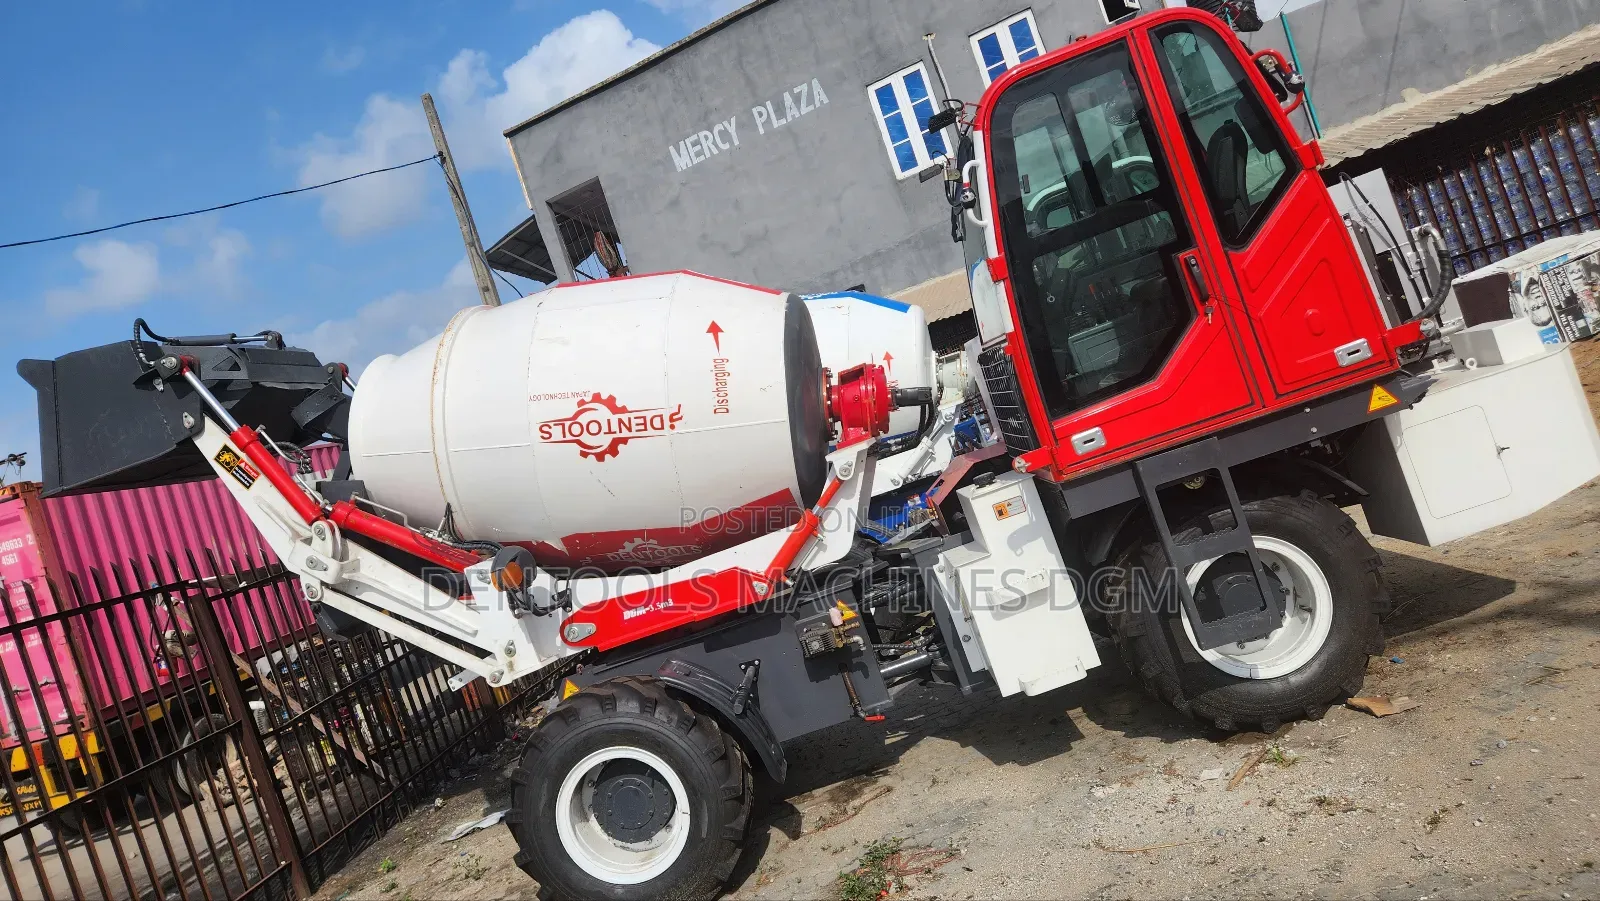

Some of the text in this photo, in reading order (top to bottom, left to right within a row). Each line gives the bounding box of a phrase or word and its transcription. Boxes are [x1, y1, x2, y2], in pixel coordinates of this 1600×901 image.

[668, 77, 830, 173] MERCY PLAZA
[528, 390, 591, 402] JAPAN TECHNOLOGY
[713, 357, 730, 415] Discharging
